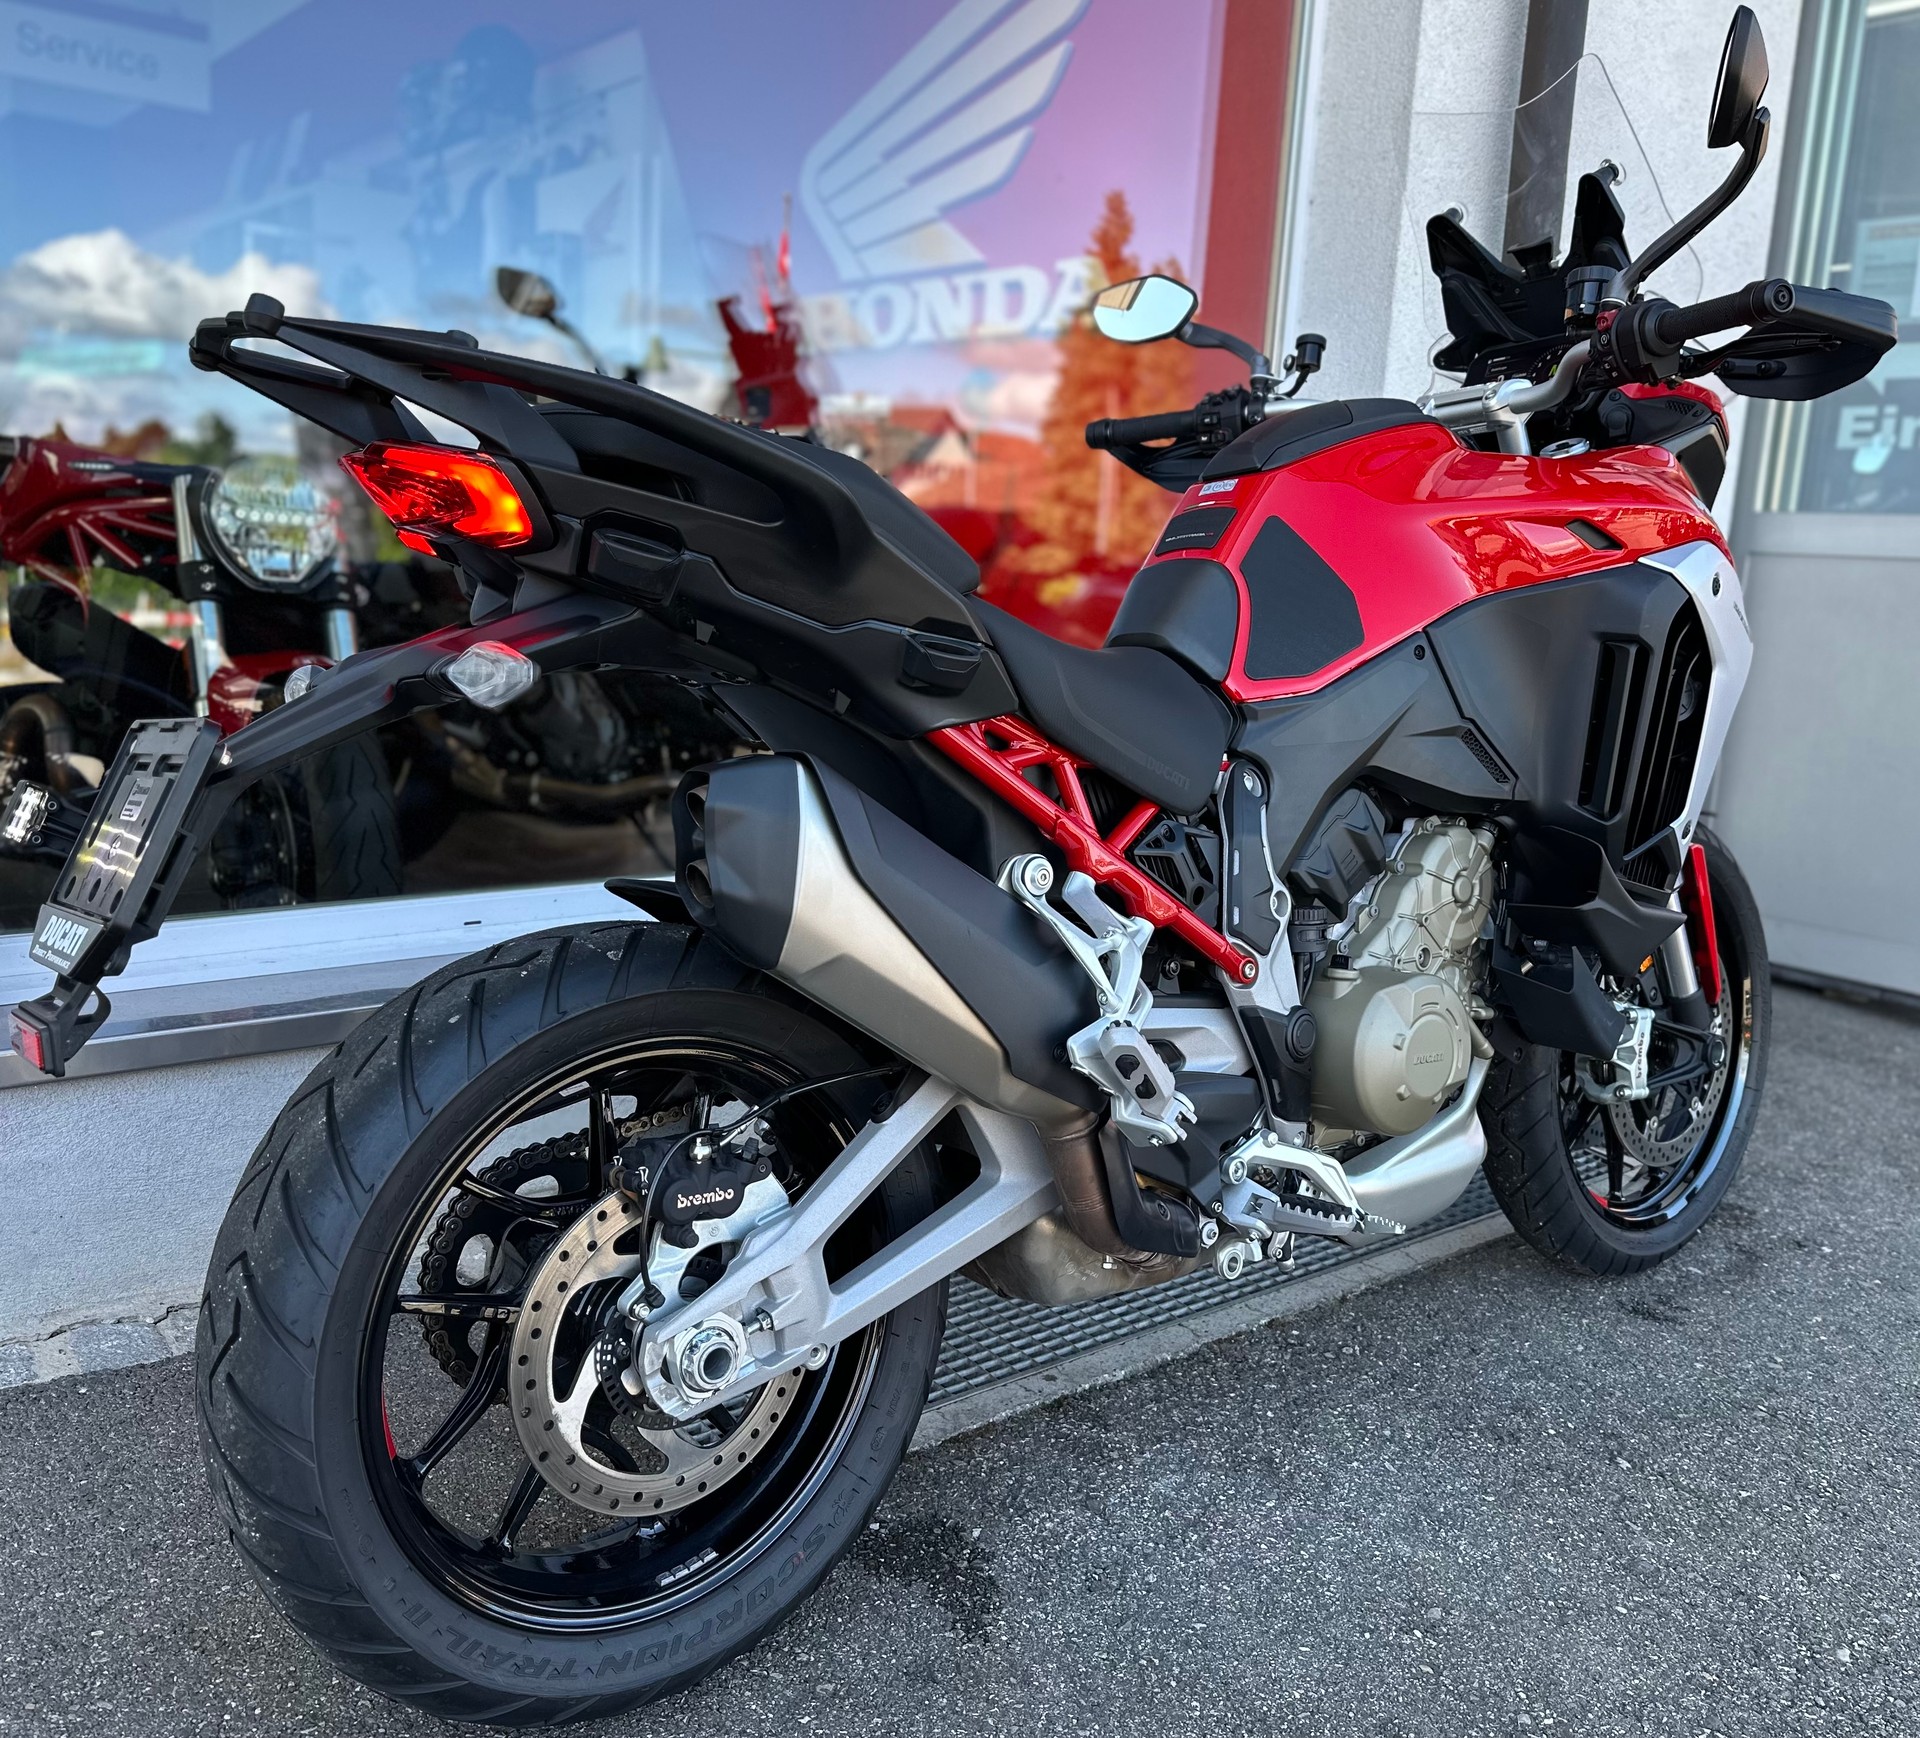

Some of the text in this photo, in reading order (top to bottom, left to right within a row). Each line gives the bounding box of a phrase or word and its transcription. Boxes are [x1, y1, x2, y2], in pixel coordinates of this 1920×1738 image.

[16, 19, 161, 81] Service
[1146, 756, 1191, 791] DUCATI
[39, 914, 89, 957] DUCATI
[1413, 1053, 1444, 1066] DUCATI
[1635, 1031, 1646, 1079] brembo
[677, 1187, 735, 1209] brembo
[596, 1523, 826, 1679] SCORPION
[446, 1625, 578, 1680] TRAIL
